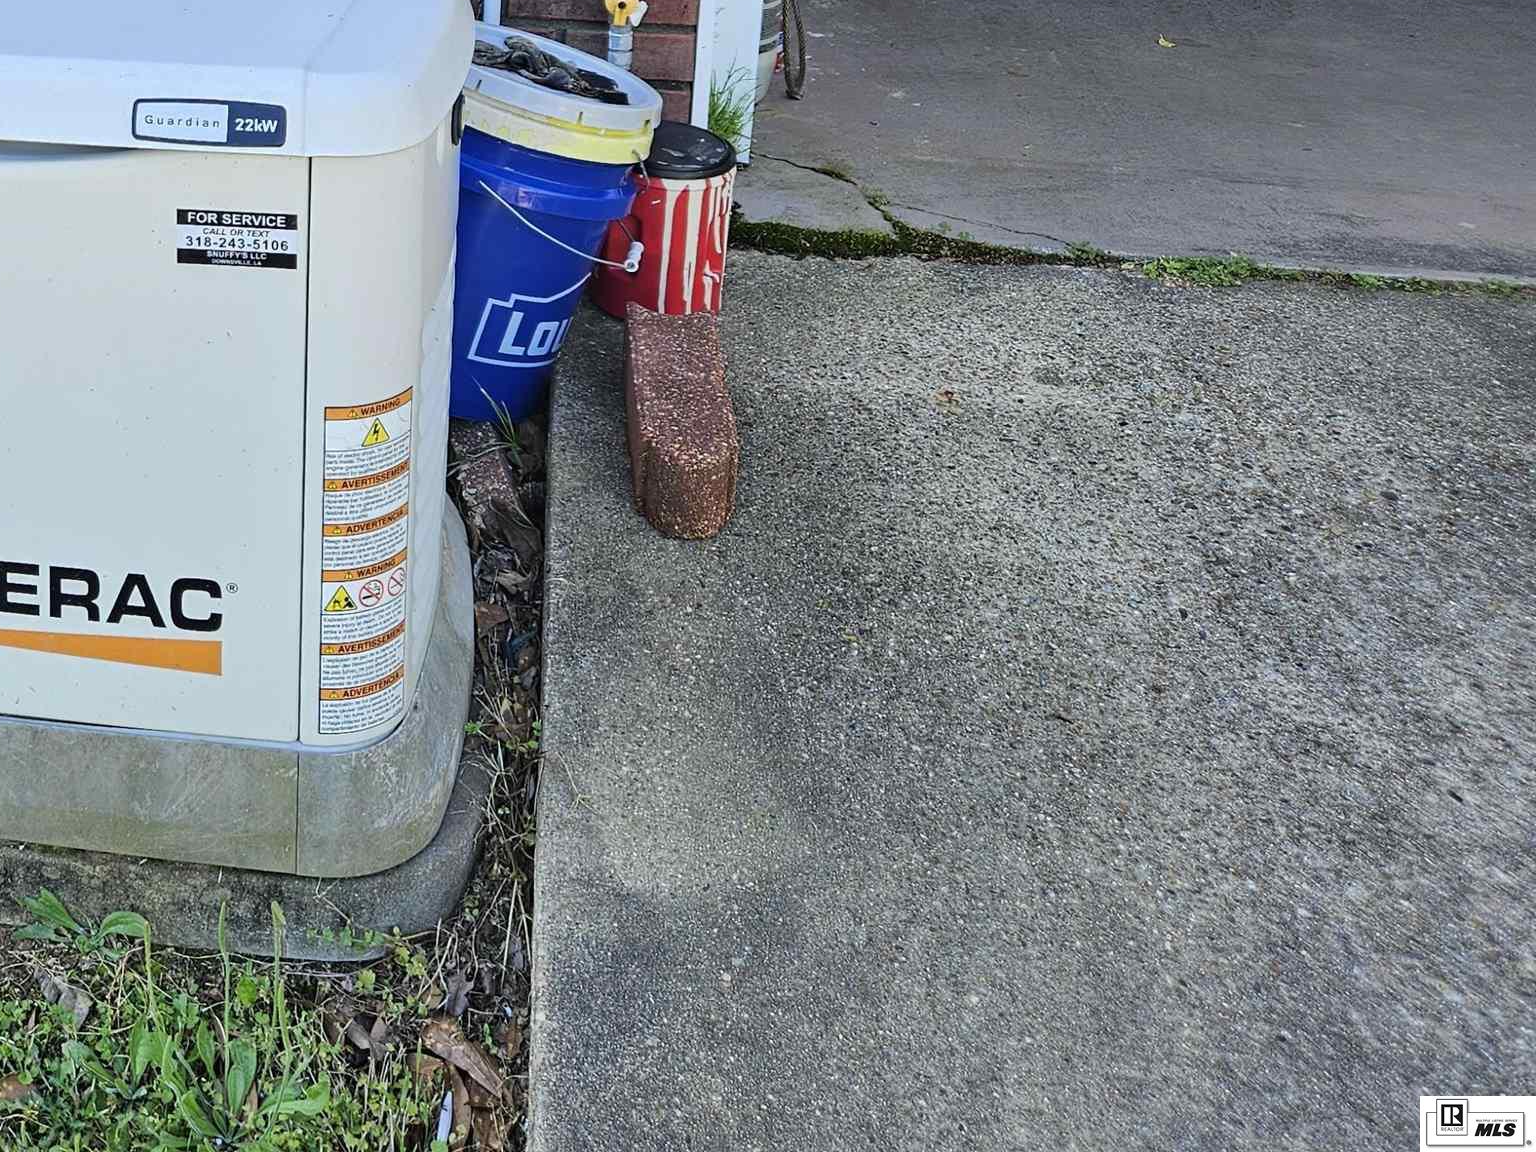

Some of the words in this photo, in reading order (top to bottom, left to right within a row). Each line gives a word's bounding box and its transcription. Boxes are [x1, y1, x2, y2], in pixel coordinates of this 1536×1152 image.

[144, 115, 220, 128] Guardian
[234, 117, 278, 134] 22kW
[187, 211, 218, 224] FOR
[222, 213, 287, 227] SERVICE
[202, 227, 225, 236] CALL
[247, 230, 270, 238] TEXT
[185, 236, 289, 251] 318-243-5106
[250, 252, 267, 260] LLC
[360, 397, 401, 416] WARNING
[357, 559, 396, 578] WARNING
